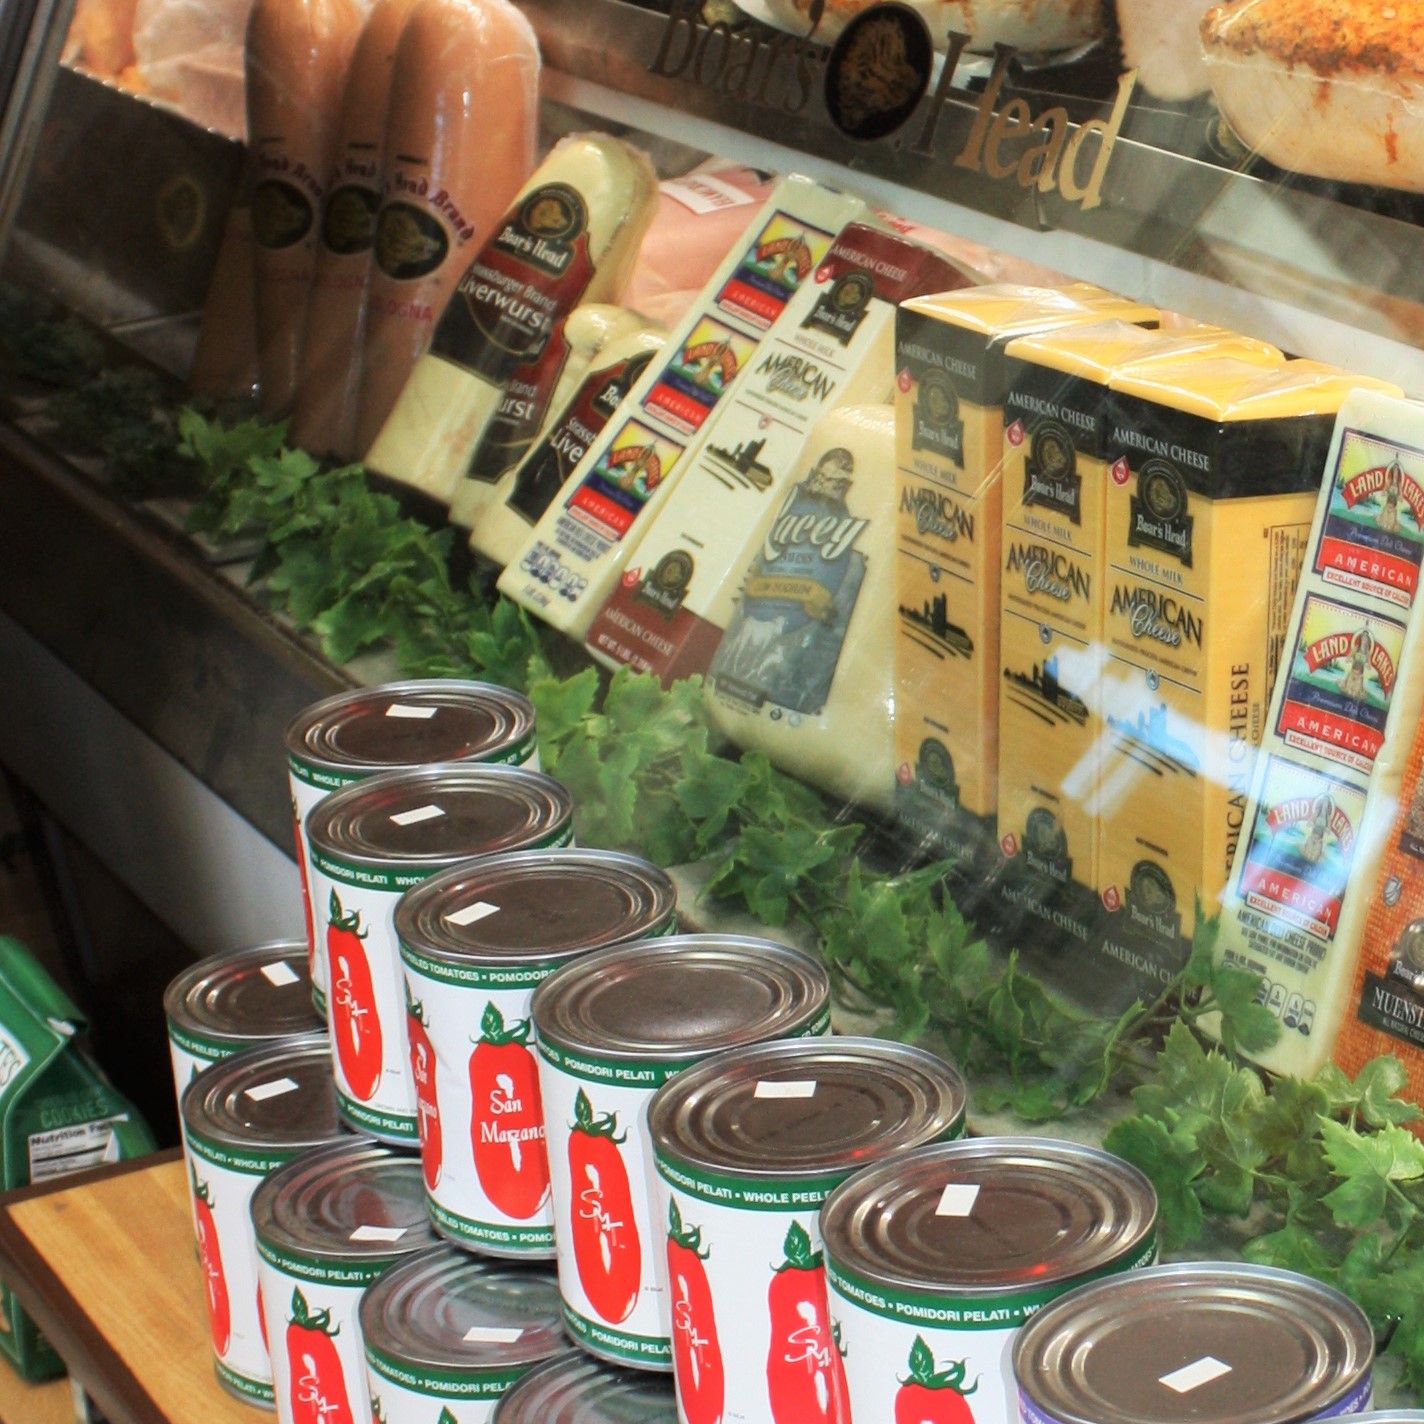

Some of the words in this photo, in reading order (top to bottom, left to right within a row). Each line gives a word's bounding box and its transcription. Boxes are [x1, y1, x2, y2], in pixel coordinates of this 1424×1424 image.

[903, 29, 1140, 212] Head
[457, 275, 552, 333] Liverwurst
[1061, 408, 1096, 433] CHEESE
[1112, 426, 1169, 458] AMERICAN
[1170, 445, 1210, 472] CHEESE
[1349, 469, 1385, 500] LAND
[1162, 566, 1184, 587] MILK
[1334, 551, 1413, 588] AMERICAN
[1312, 636, 1349, 664] LAND
[1369, 640, 1394, 687] LAKES
[1296, 714, 1378, 755] AMERICAN
[1274, 800, 1310, 825] LAND
[563, 1056, 613, 1079] POMIDORI
[614, 1067, 656, 1083] PELATI
[490, 1090, 523, 1115] San
[696, 1181, 733, 1200] PELATI
[742, 1190, 790, 1205] WHOLE
[896, 1302, 962, 1322] POMIDORI
[963, 1308, 1011, 1323] PELATI
